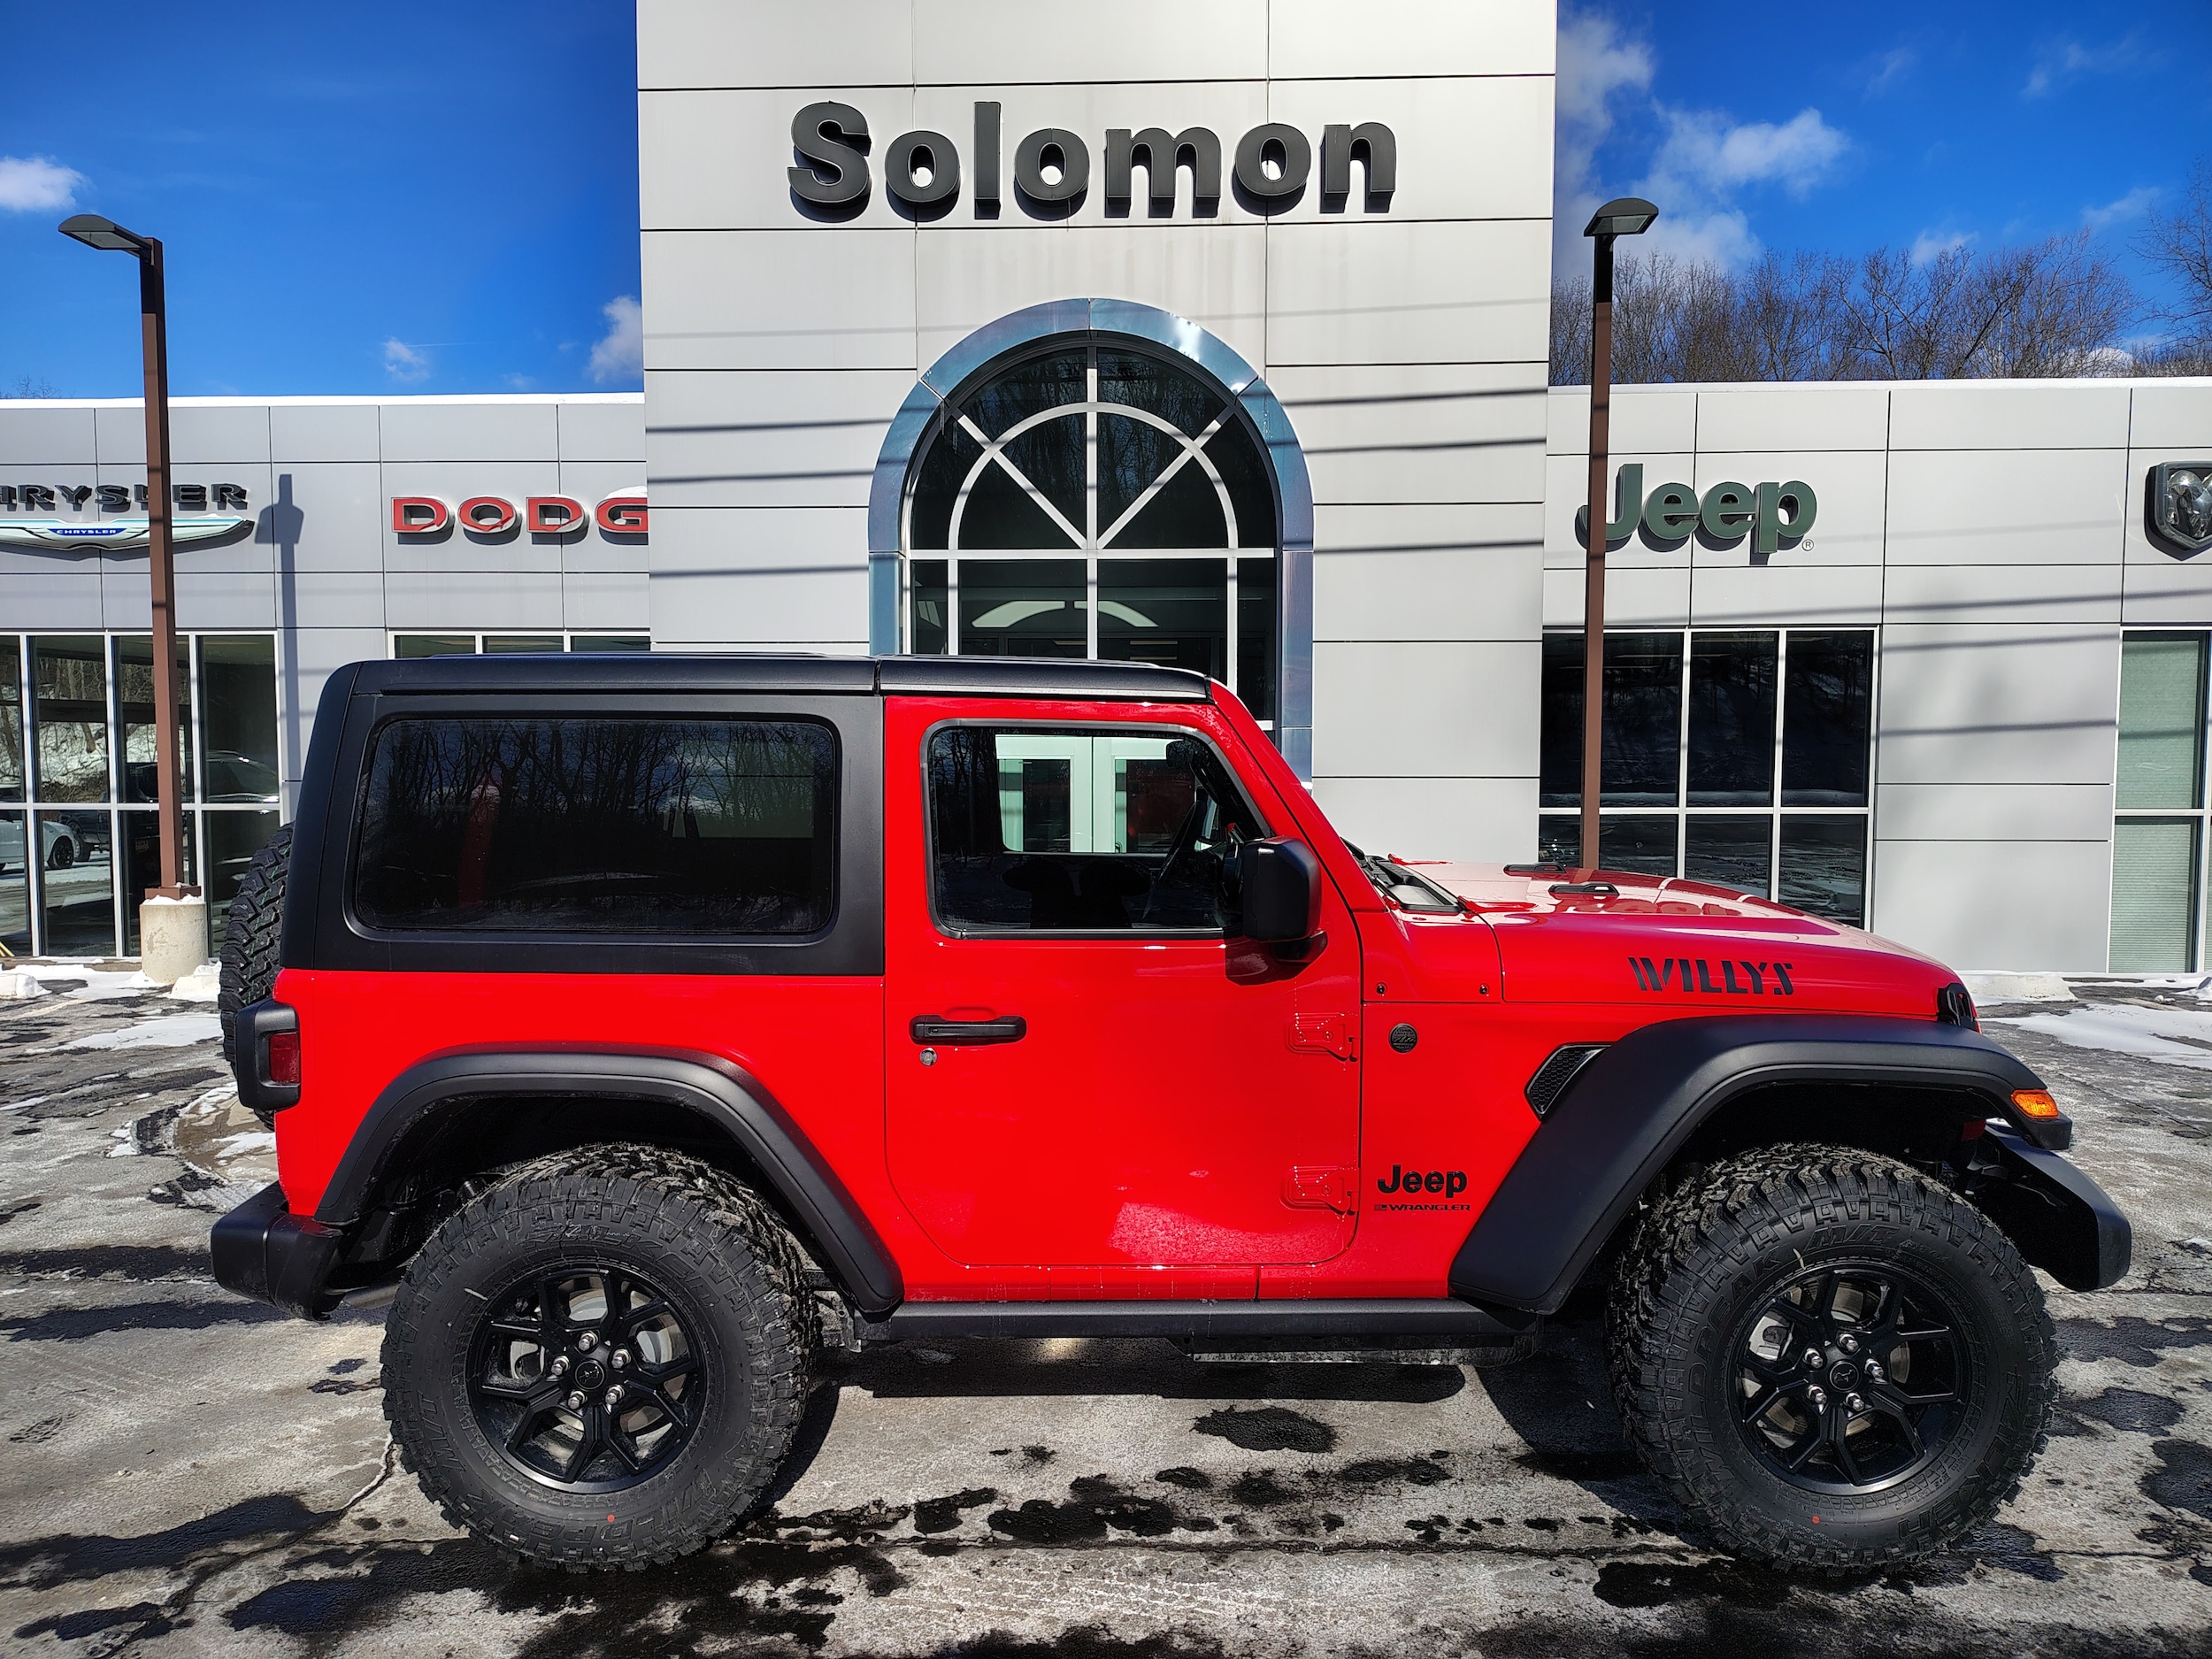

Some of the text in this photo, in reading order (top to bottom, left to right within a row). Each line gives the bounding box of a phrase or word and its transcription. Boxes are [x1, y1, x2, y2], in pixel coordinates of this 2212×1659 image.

[787, 100, 1396, 217] Solomon
[391, 496, 648, 533] DODG
[1575, 463, 1816, 554] Jeep
[1628, 956, 1793, 995] WILLYS
[1377, 1164, 1467, 1198] Jeep
